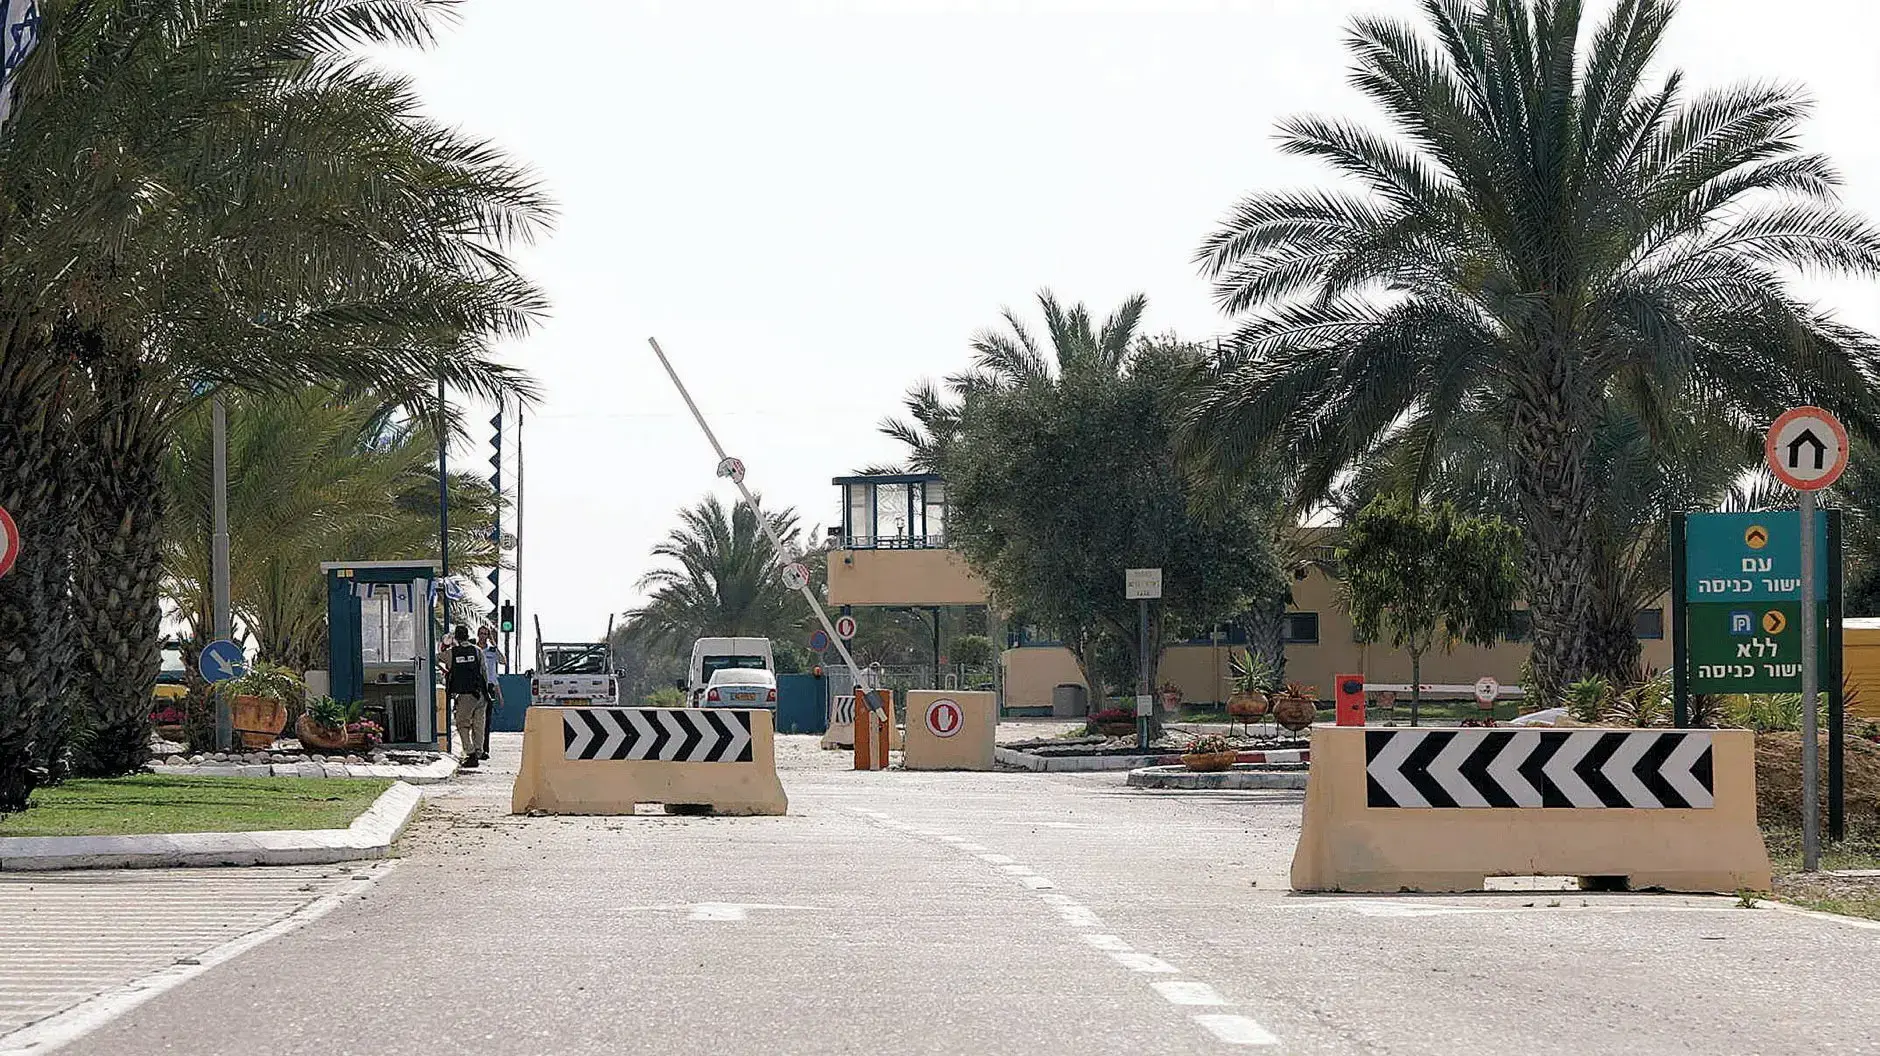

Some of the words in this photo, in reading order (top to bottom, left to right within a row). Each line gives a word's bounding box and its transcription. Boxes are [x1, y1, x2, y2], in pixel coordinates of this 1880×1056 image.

[1742, 558, 1772, 572] עם
[1698, 579, 1753, 593] כניסה
[1762, 579, 1801, 592] ישור
[1737, 637, 1778, 658] ללא
[1698, 665, 1755, 678] כניסה
[1763, 664, 1803, 677] ישור
